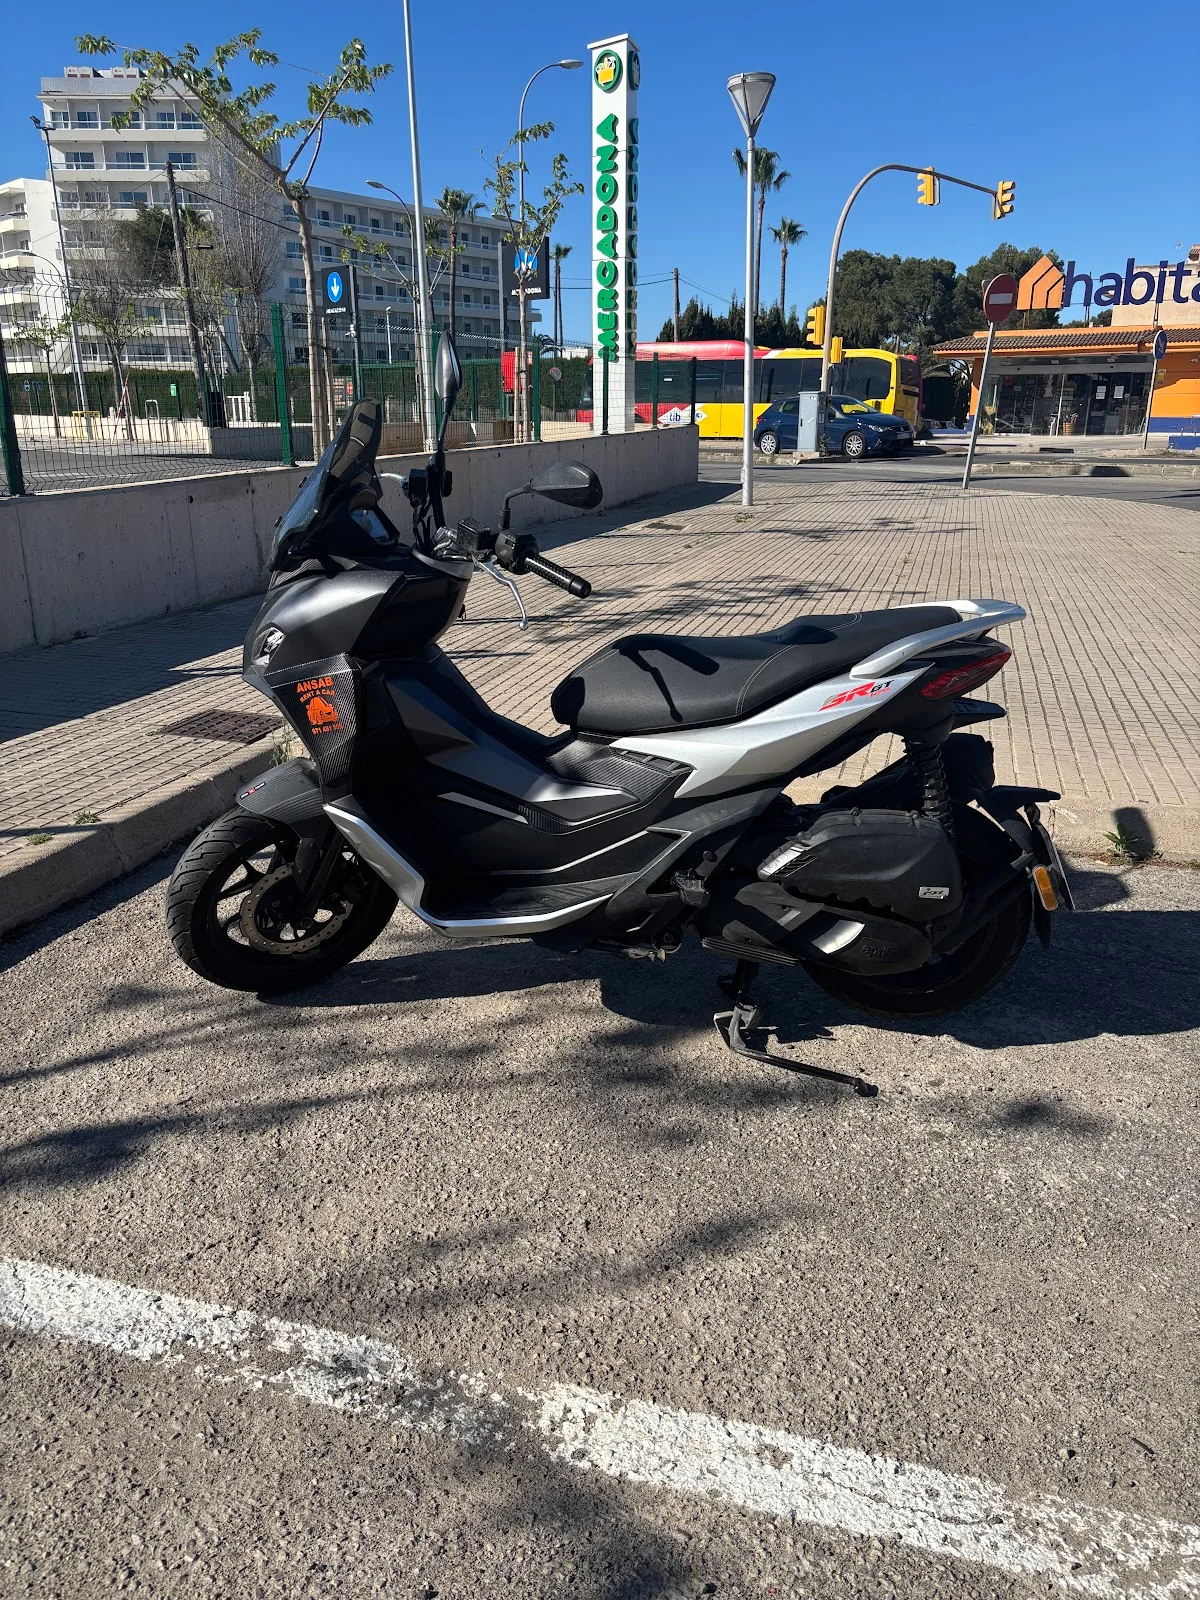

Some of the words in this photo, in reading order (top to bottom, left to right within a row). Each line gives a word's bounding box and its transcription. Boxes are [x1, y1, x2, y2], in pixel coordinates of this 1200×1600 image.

[596, 113, 619, 363] MERCADONA
[296, 676, 334, 693] ANSAB
[300, 690, 315, 703] RENT
[321, 689, 335, 697] CAR
